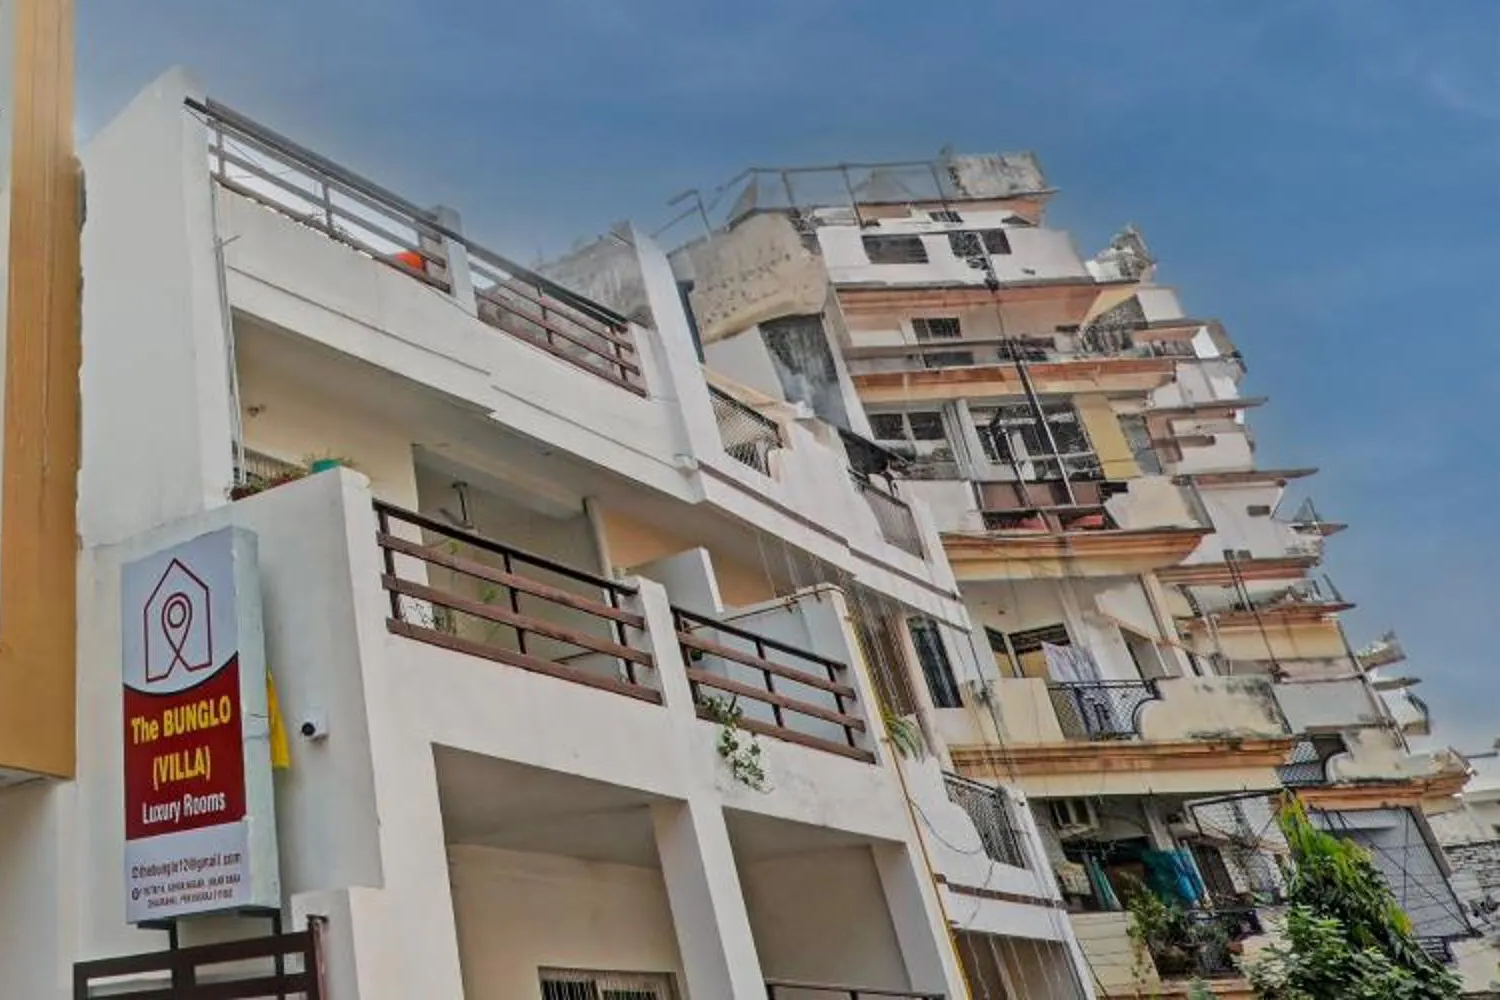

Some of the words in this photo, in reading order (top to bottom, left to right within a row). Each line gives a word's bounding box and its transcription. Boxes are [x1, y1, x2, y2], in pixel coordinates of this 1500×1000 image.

[131, 716, 159, 745] The
[163, 695, 231, 737] BUNGLO
[153, 745, 211, 791] (VILLA)
[142, 802, 180, 824] Luxury
[183, 792, 226, 817] Rooms
